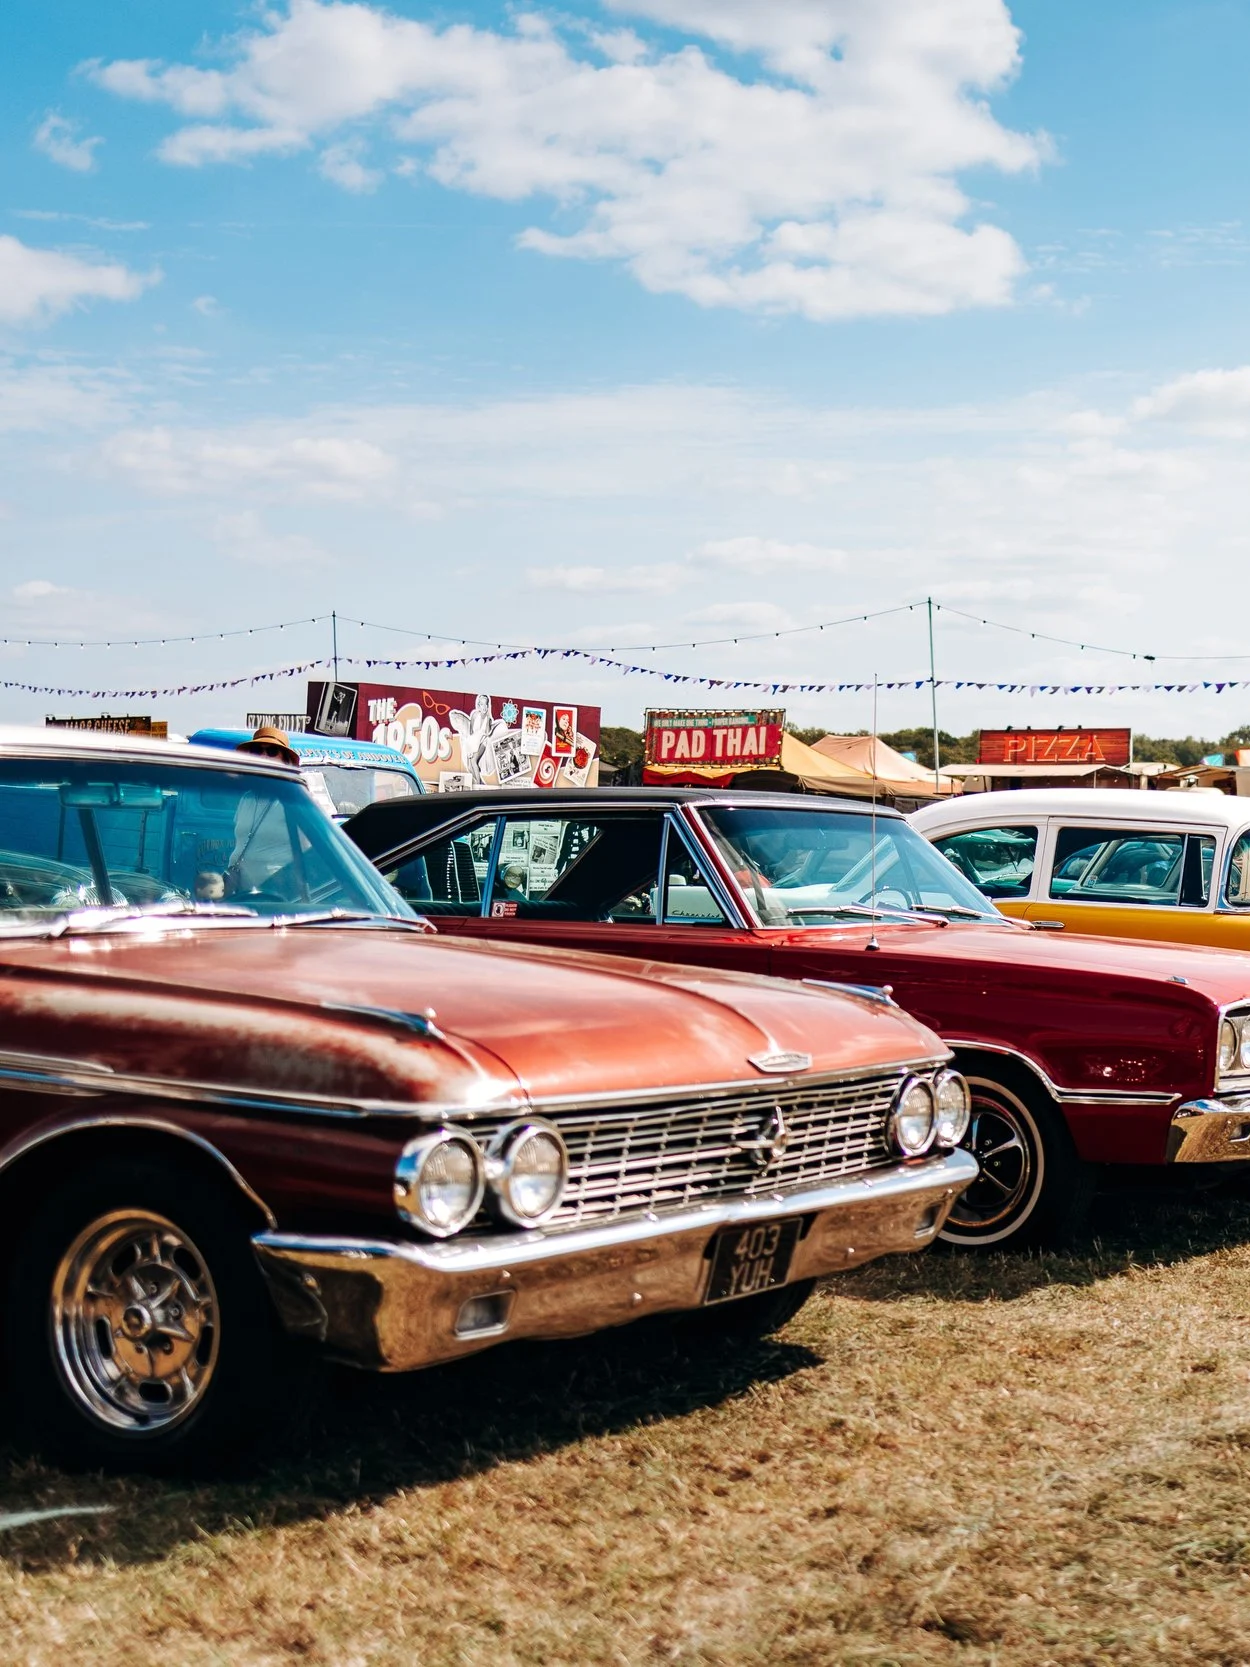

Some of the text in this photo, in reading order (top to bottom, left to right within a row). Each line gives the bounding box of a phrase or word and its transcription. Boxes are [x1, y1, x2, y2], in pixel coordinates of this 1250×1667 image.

[367, 697, 397, 724] THE
[95, 719, 131, 736] CHEESE
[372, 715, 453, 765] 1950s
[661, 726, 767, 759] PAD THAI
[298, 749, 341, 760] ULPITT'S
[343, 750, 356, 760] OF
[1003, 735, 1107, 762] PIZZA
[734, 1224, 782, 1260] 403
[729, 1256, 775, 1297] YUH
